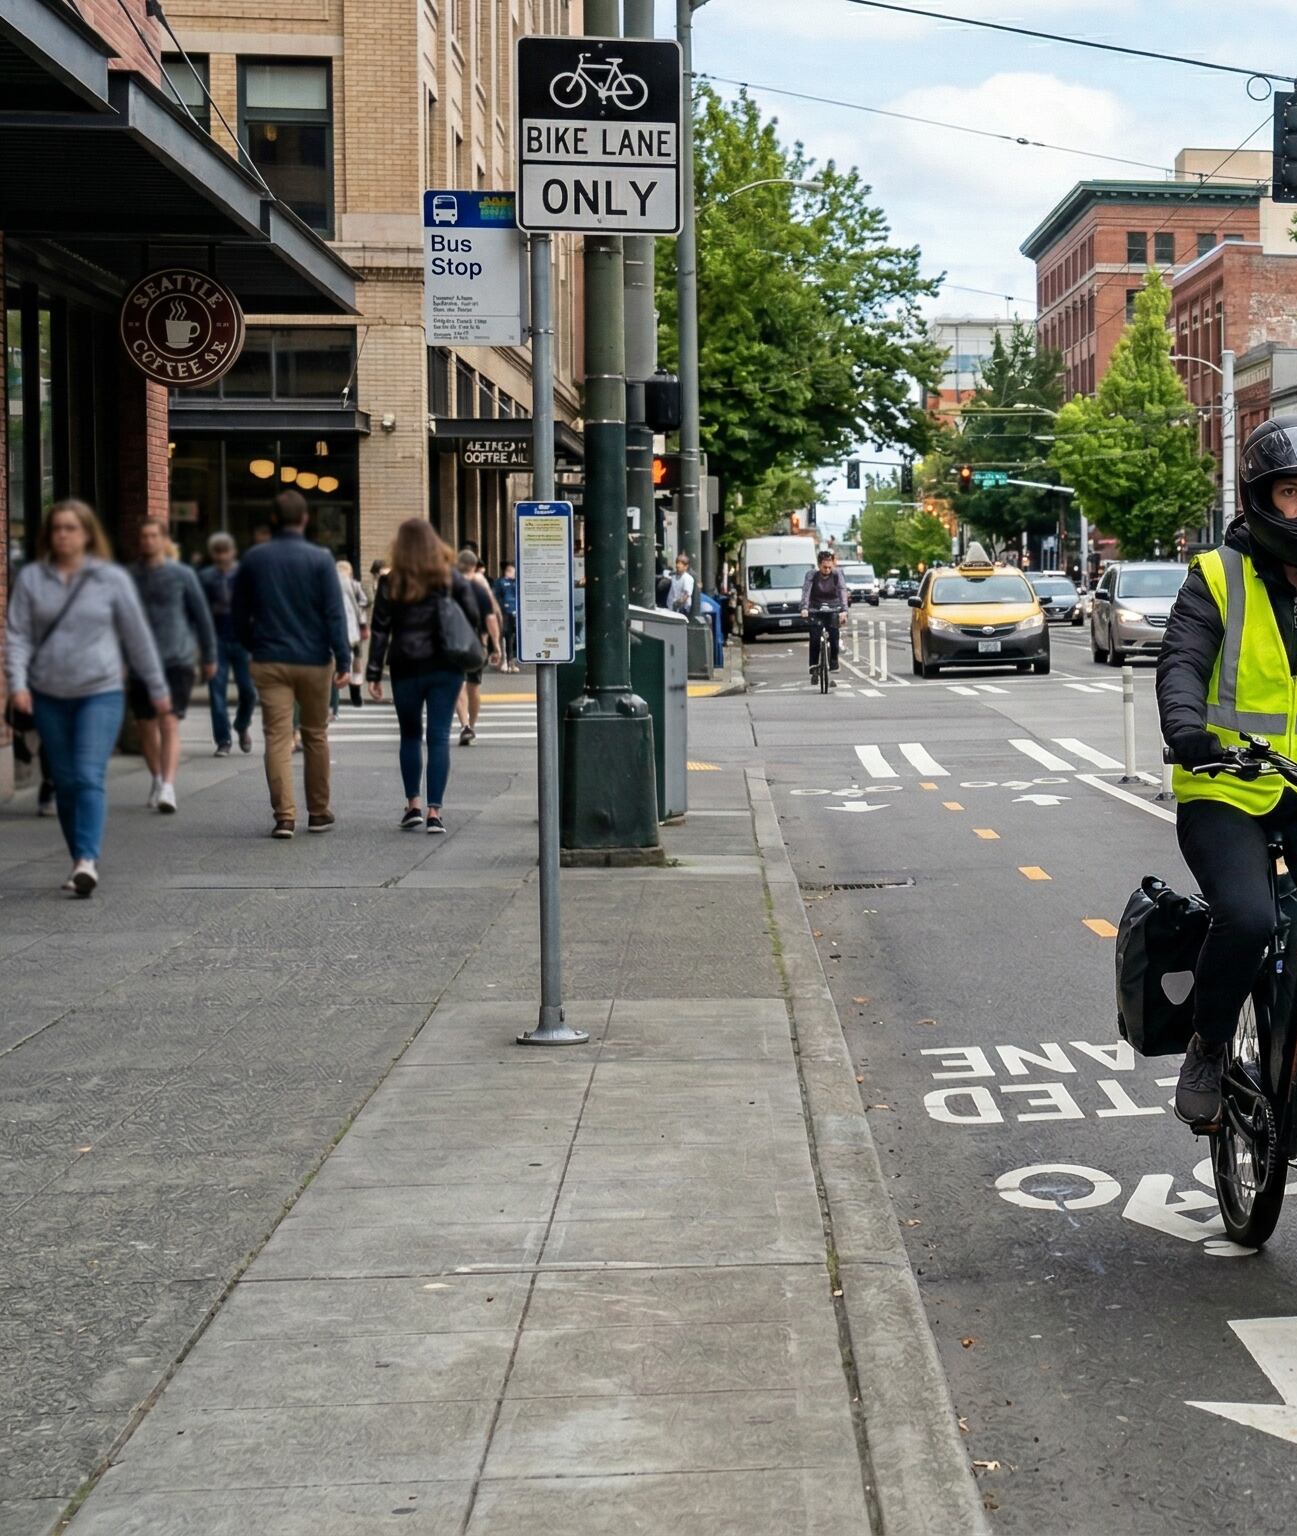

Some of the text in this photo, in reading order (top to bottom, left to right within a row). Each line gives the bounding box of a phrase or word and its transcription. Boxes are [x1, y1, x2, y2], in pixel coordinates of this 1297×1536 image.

[527, 126, 671, 157] BIKE LANE
[542, 178, 658, 216] ONLY
[431, 234, 472, 252] Bus
[431, 257, 482, 279] Stop
[920, 1039, 1136, 1080] ANE
